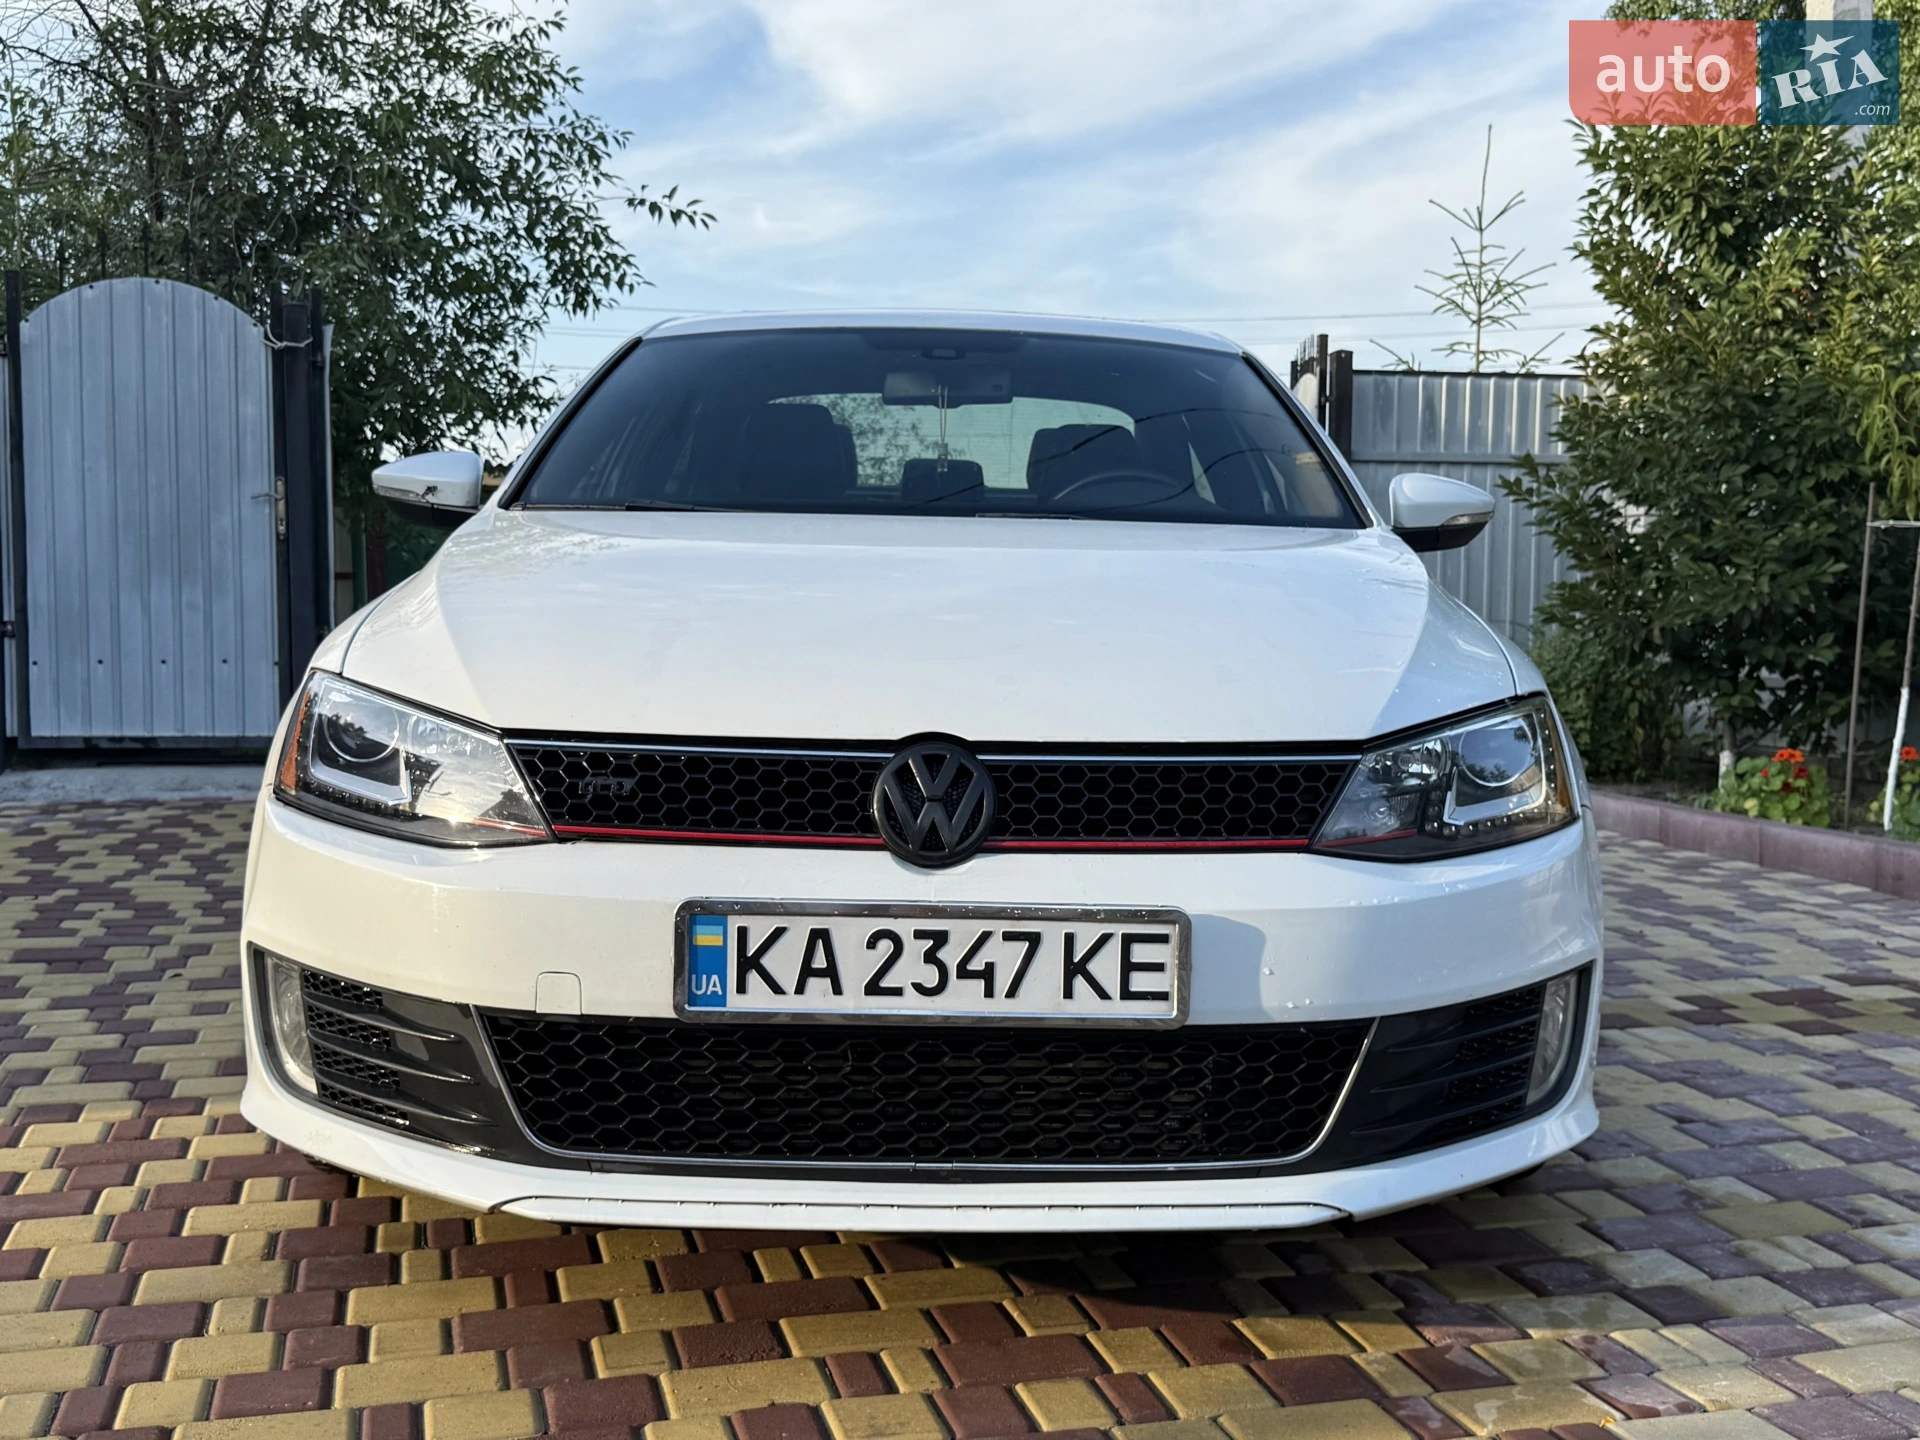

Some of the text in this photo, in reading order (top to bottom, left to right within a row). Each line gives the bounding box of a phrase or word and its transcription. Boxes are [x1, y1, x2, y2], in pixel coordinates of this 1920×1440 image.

[691, 974, 723, 996] UA
[735, 925, 1171, 1001] KA 2347 KE
